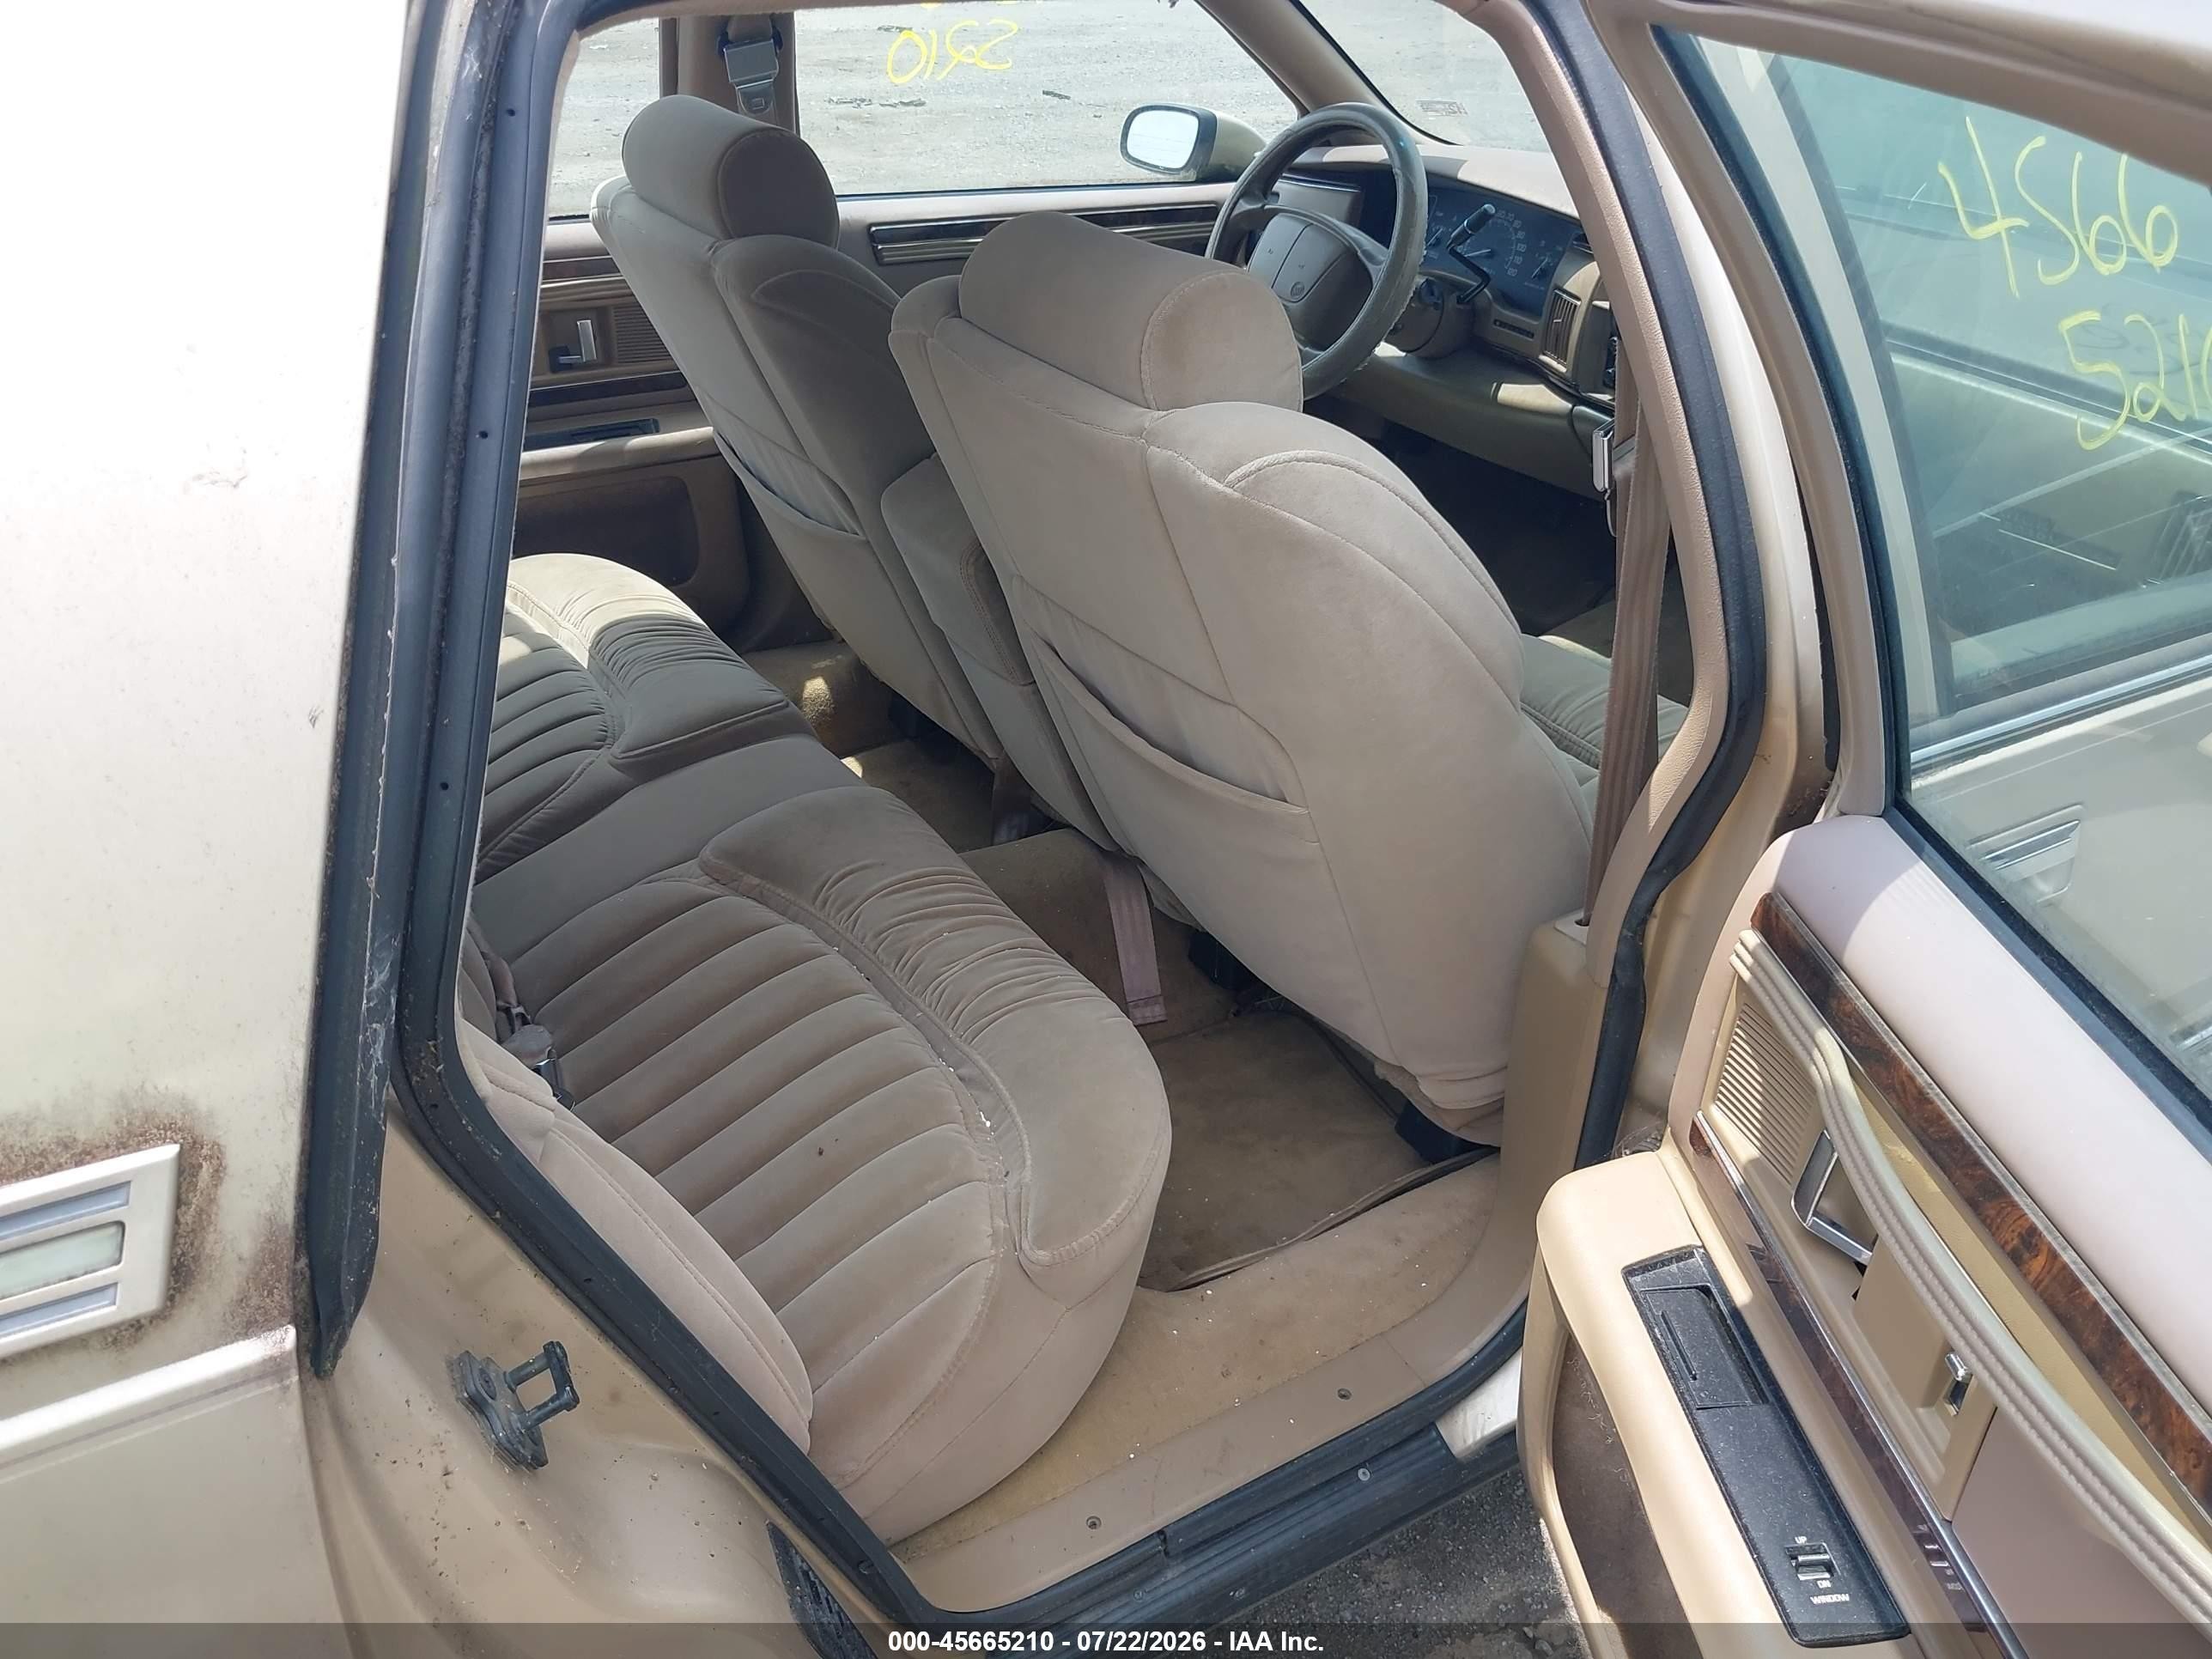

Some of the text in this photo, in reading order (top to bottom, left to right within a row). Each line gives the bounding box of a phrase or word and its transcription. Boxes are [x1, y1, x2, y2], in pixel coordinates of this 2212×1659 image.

[1937, 116, 2179, 300] 4566
[1795, 1535, 1808, 1544] UP
[1809, 1593, 1850, 1605] WINDOW
